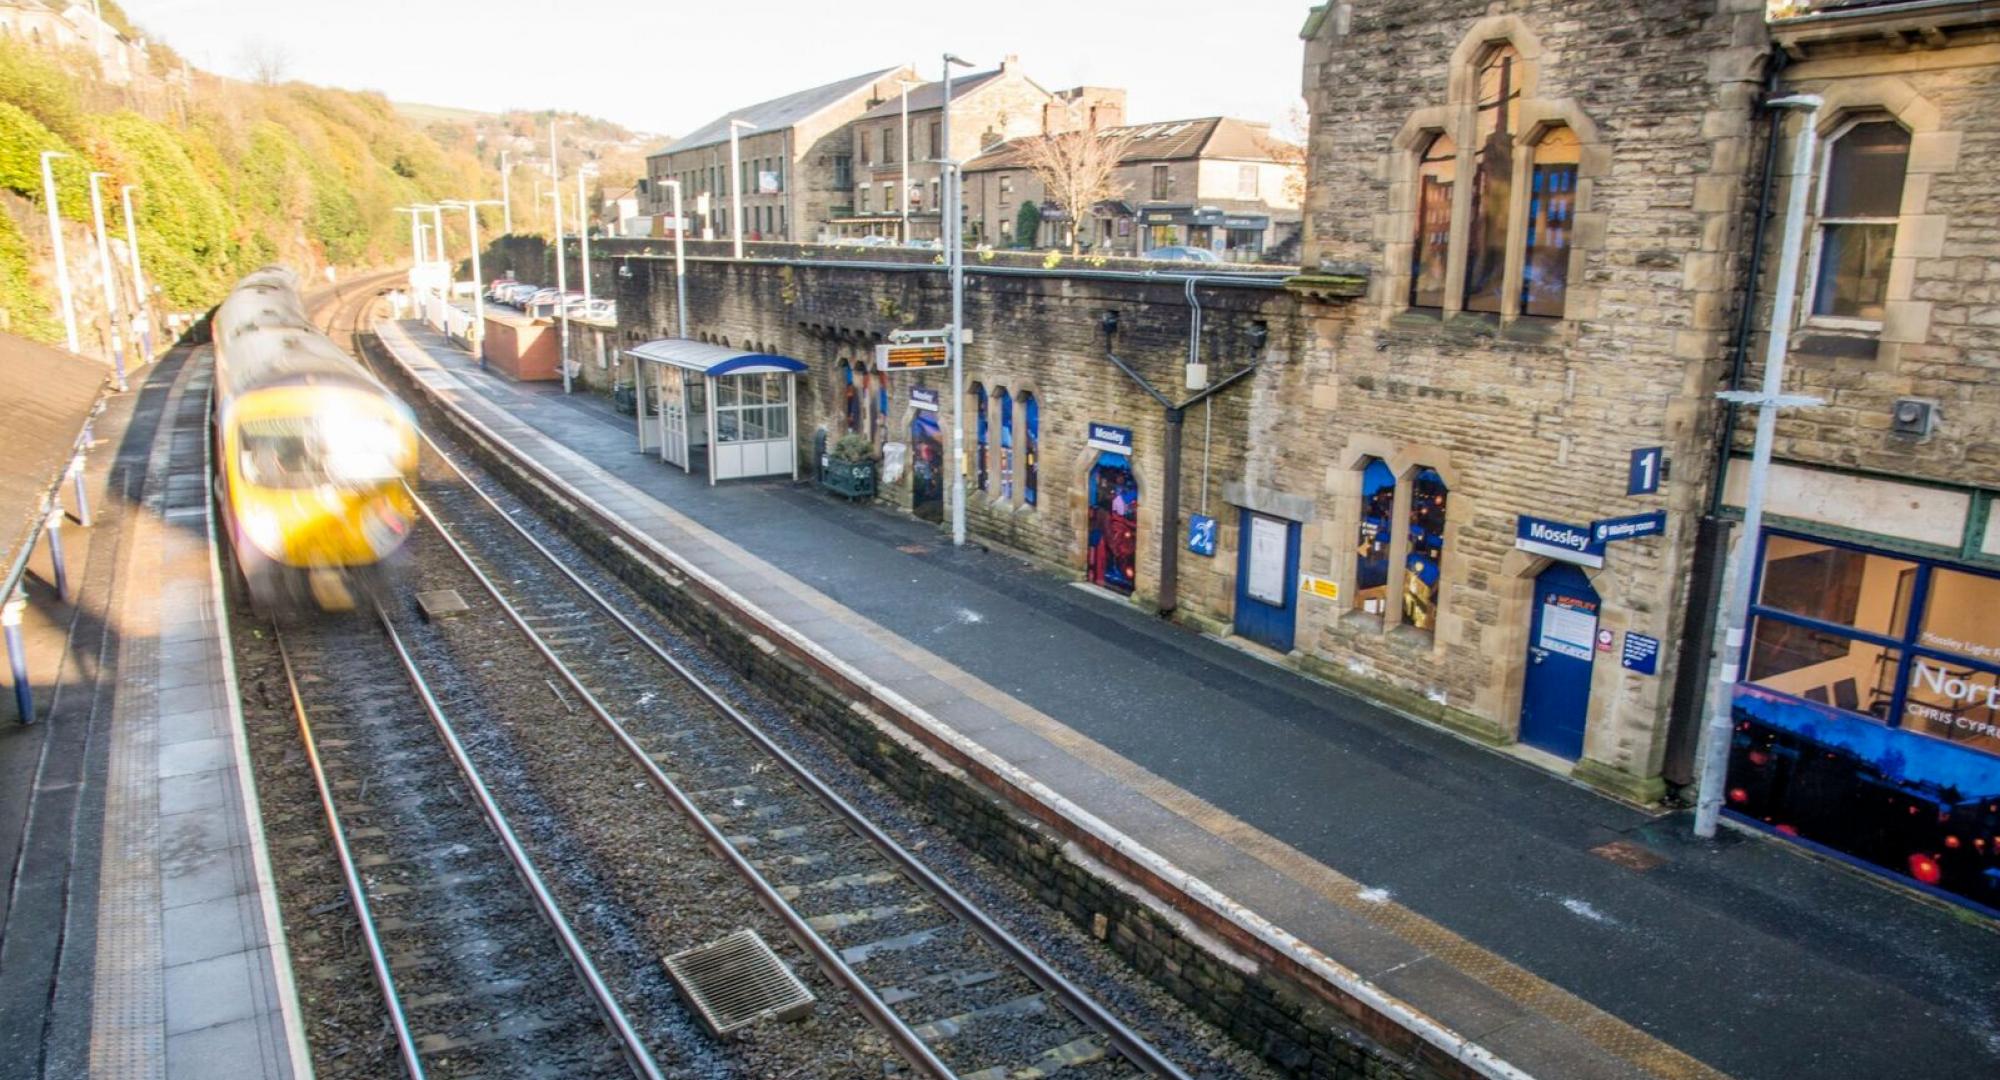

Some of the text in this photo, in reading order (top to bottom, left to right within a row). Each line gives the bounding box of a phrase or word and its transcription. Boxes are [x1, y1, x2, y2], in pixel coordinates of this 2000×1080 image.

[1095, 427, 1125, 445] Mossley
[1640, 452, 1655, 489] 1
[1530, 522, 1590, 551] Mossley
[1608, 520, 1656, 536] Waiting room
[1921, 631, 1962, 650] Mossley
[1912, 660, 2000, 710] Nort
[1907, 703, 1952, 725] CHRIS
